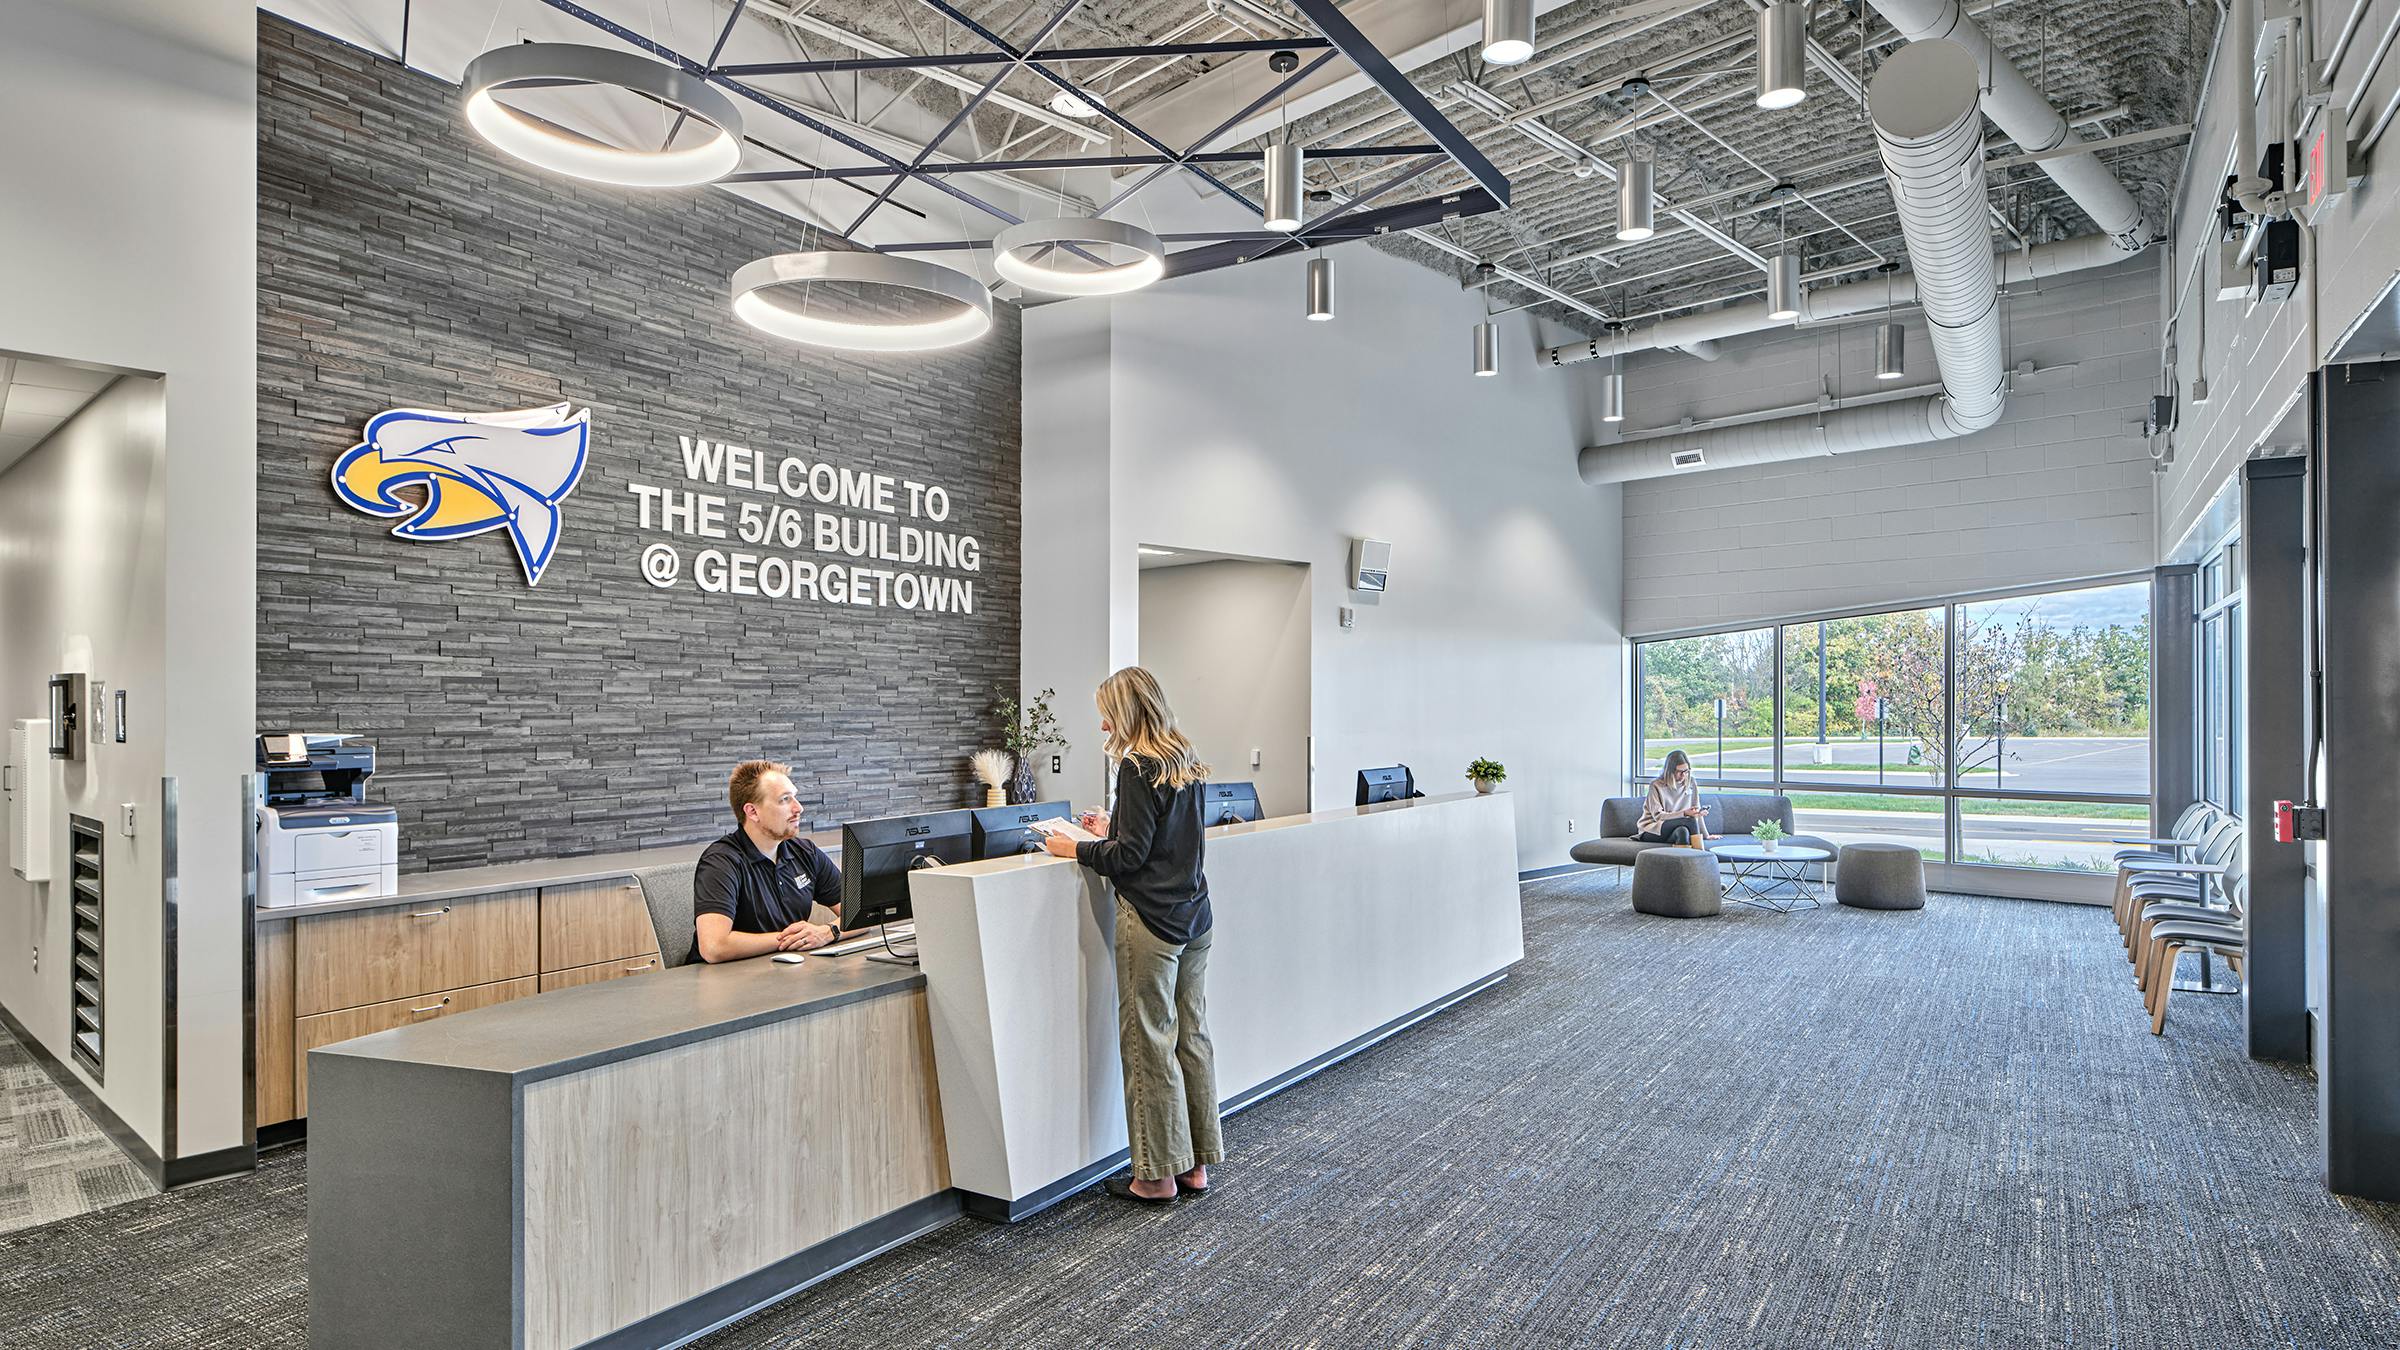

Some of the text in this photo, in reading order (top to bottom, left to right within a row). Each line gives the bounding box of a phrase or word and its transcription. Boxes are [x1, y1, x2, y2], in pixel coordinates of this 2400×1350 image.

[679, 435, 950, 522] WELCOME TO
[628, 483, 980, 572] THE 5/6 BUILDING
[640, 543, 973, 614] @ GEORGETOWN
[905, 825, 931, 837] ASUS
[1018, 814, 1040, 824] ASUS
